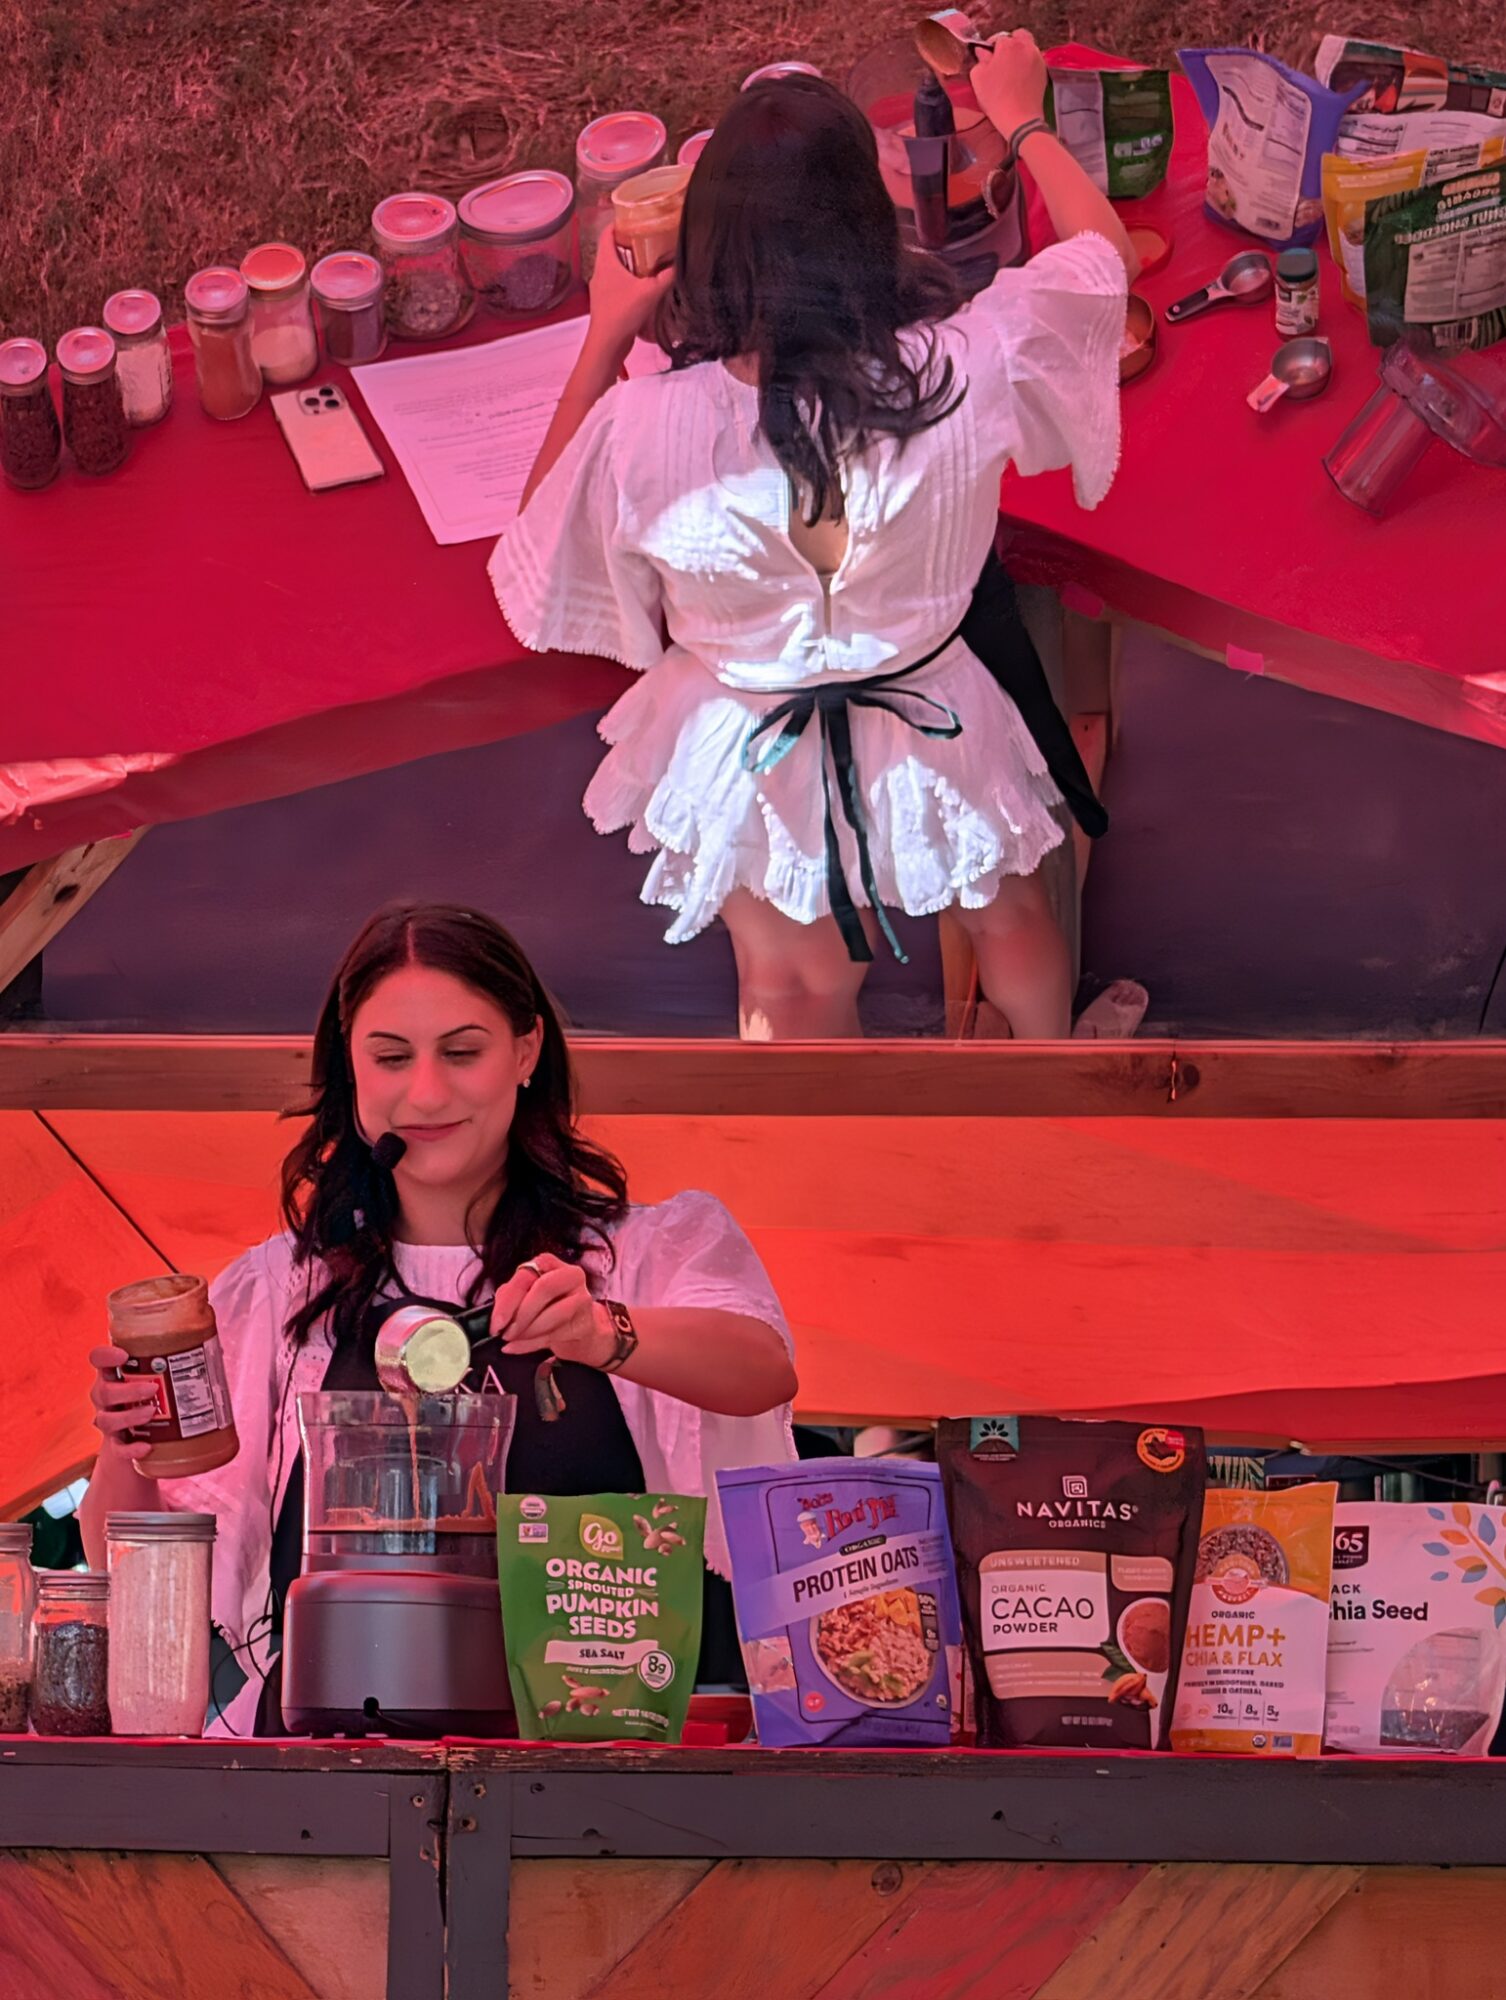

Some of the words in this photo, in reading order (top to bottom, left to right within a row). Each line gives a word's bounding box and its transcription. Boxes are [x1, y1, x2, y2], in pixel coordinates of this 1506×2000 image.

[1016, 1501, 1134, 1520] NAVITAS
[1049, 1519, 1106, 1529] ORGANICS
[990, 1556, 1080, 1568] UNSWEETENED
[546, 1558, 658, 1587] ORGANIC
[793, 1556, 878, 1602] PROTEIN
[881, 1546, 919, 1574] OATS
[567, 1579, 635, 1597] SPROUTED
[991, 1584, 1046, 1594] ORGANIC
[546, 1593, 659, 1618] PUMPKIN
[991, 1597, 1094, 1620] CACAO
[1329, 1600, 1366, 1620] hia
[1372, 1600, 1429, 1621] Seed
[1211, 1611, 1255, 1620] ORGANIC
[569, 1615, 637, 1639] SEEDS
[993, 1622, 1058, 1634] POWDER
[1185, 1624, 1286, 1648] HEMP+
[579, 1649, 598, 1658] SEA
[600, 1649, 625, 1660] SALT
[1186, 1652, 1218, 1667] CHIA
[1222, 1652, 1233, 1666] &
[1238, 1651, 1283, 1667] FLAX
[647, 1656, 666, 1674] 8g
